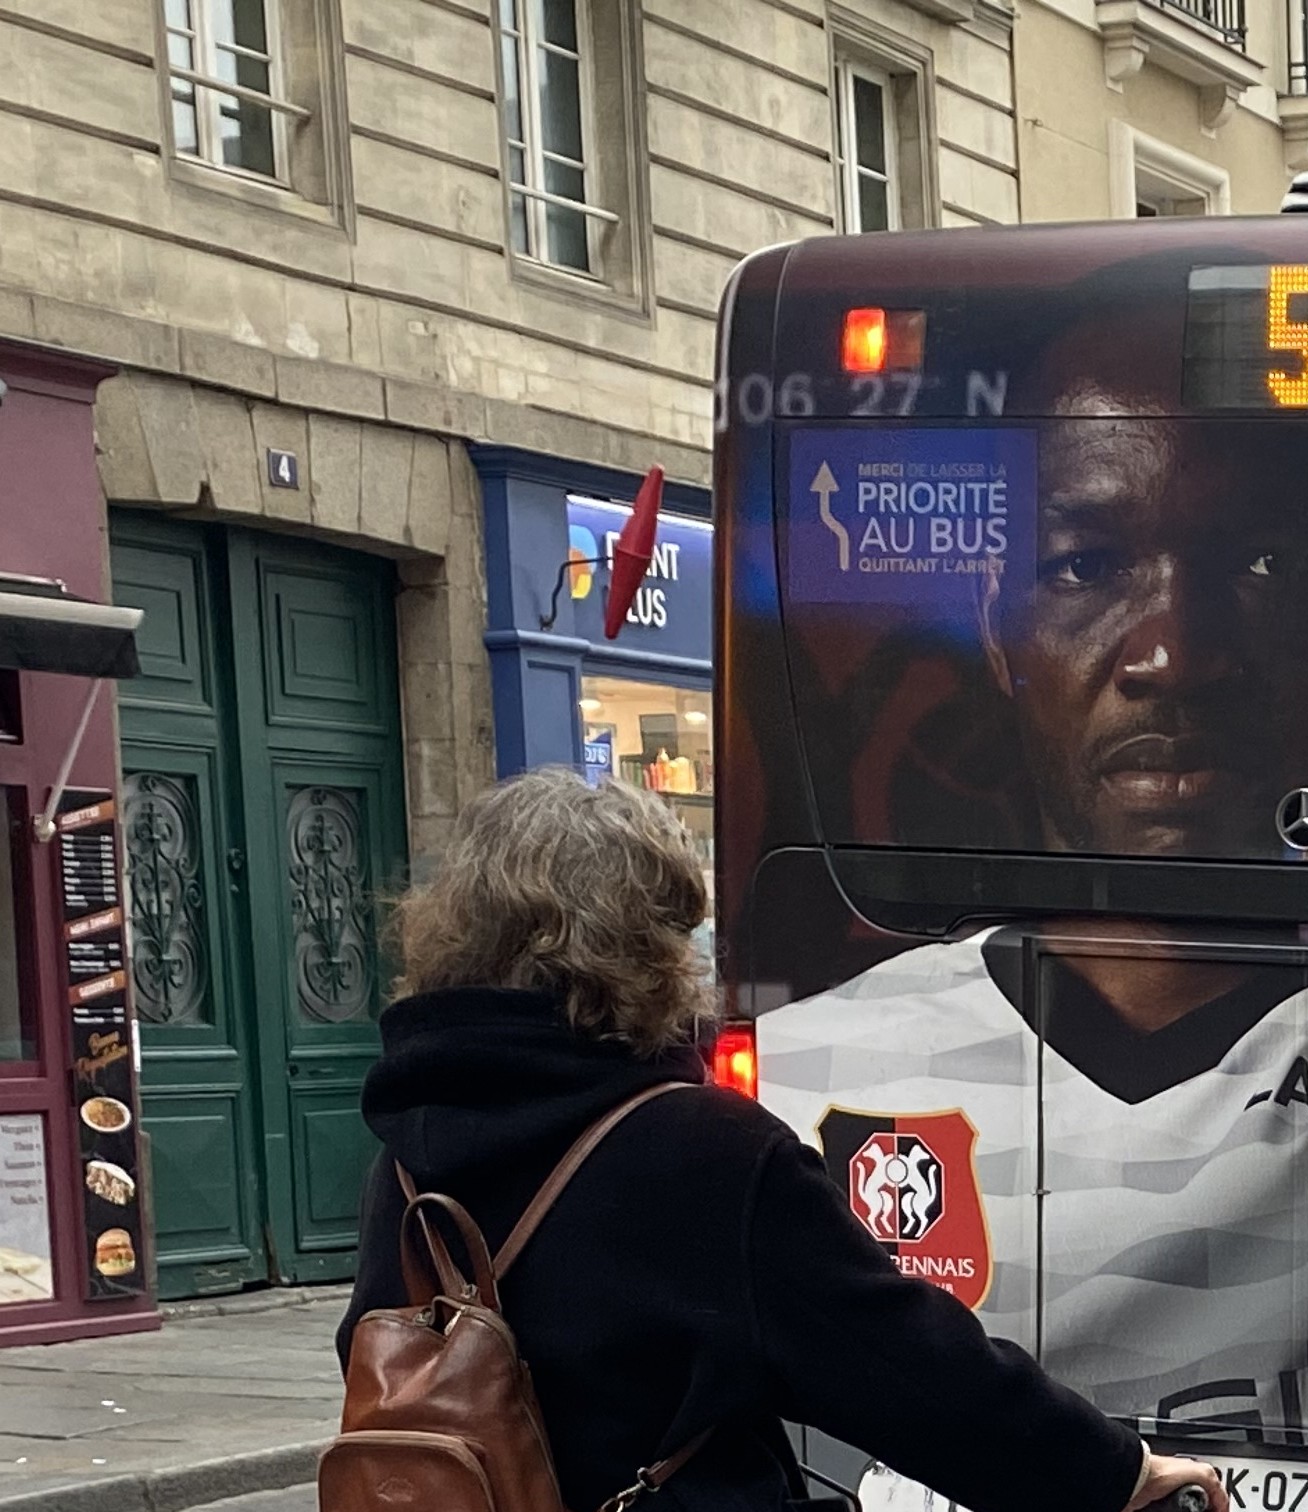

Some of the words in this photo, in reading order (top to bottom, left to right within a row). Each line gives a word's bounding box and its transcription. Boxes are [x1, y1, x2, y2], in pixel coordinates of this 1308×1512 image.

[278, 455, 291, 482] 4
[858, 463, 904, 477] MERCI
[907, 463, 926, 477] DE
[929, 463, 985, 477] LAISSER
[989, 463, 1007, 477] LA
[858, 480, 1008, 514] PRIORITÉ
[859, 516, 915, 553] AU
[930, 517, 1008, 554] BUS
[859, 557, 939, 573] QUITTANT
